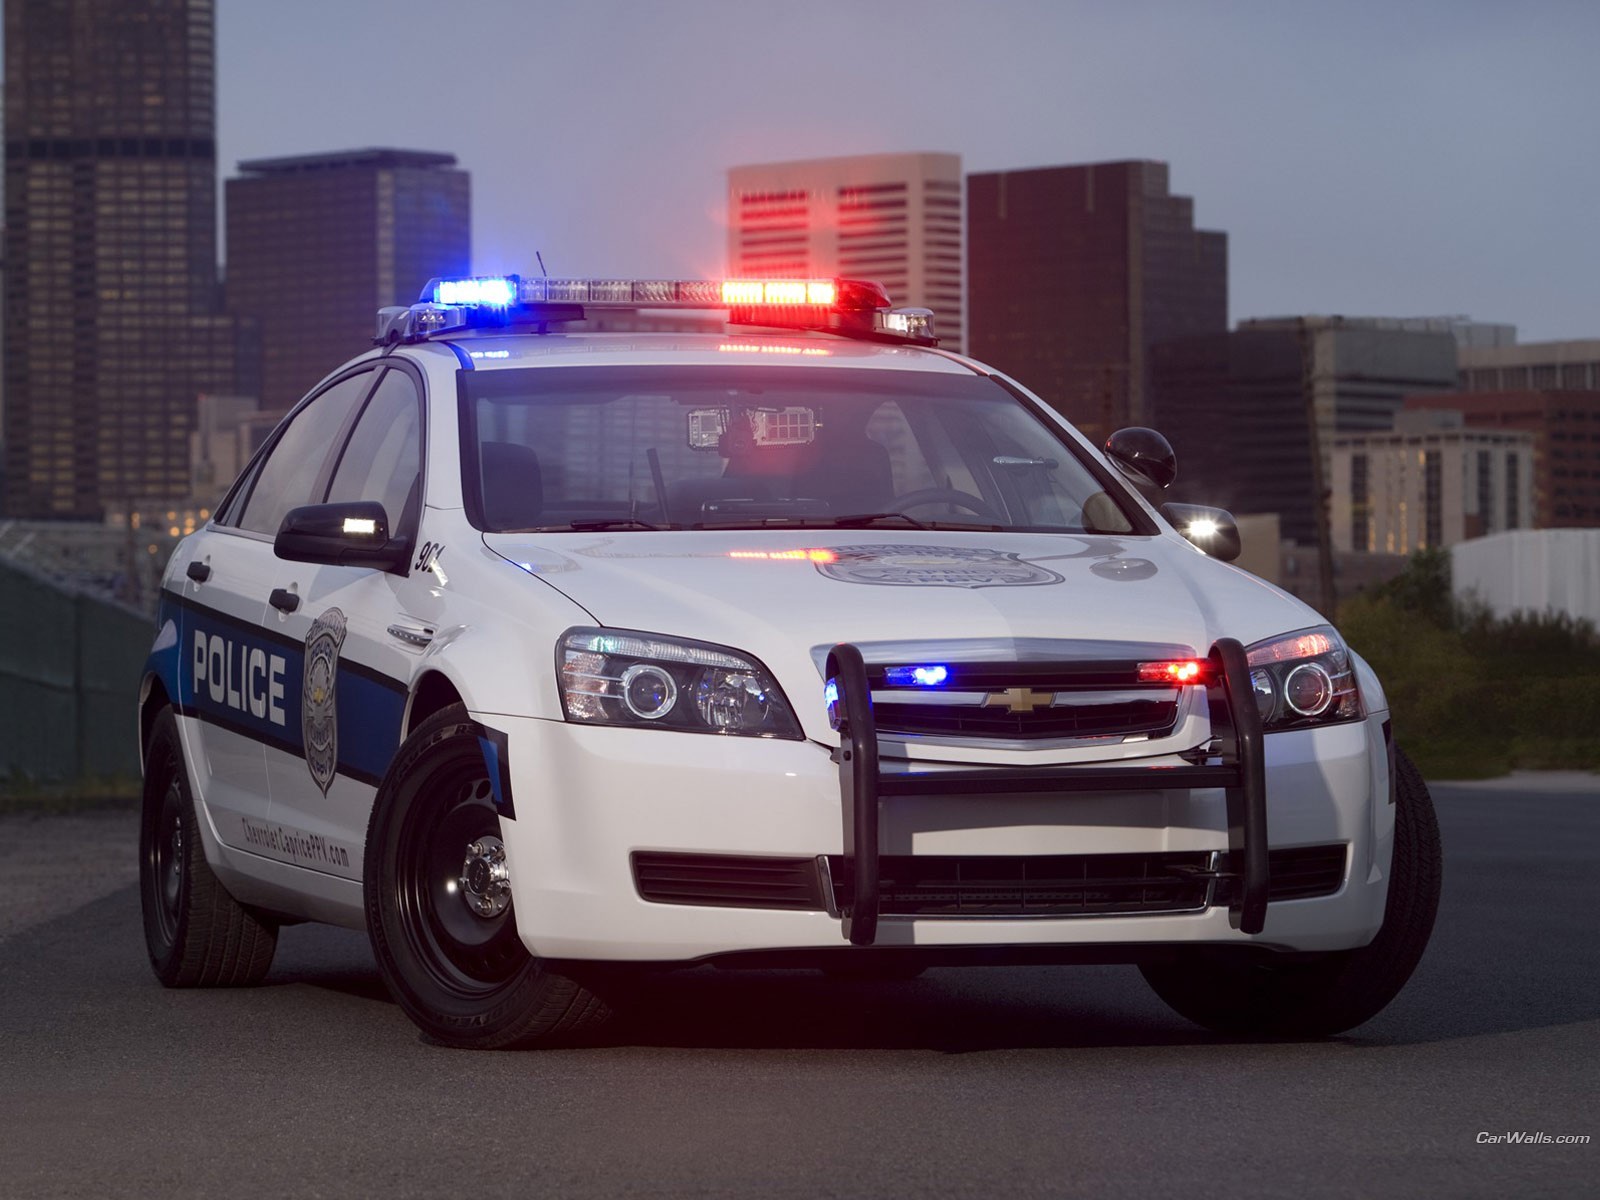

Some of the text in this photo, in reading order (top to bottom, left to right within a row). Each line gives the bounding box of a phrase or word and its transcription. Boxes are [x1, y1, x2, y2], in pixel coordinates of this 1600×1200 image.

[415, 541, 446, 573] 9C1
[193, 629, 286, 727] POLICE
[242, 817, 349, 867] ChevroletCapricePPV.com
